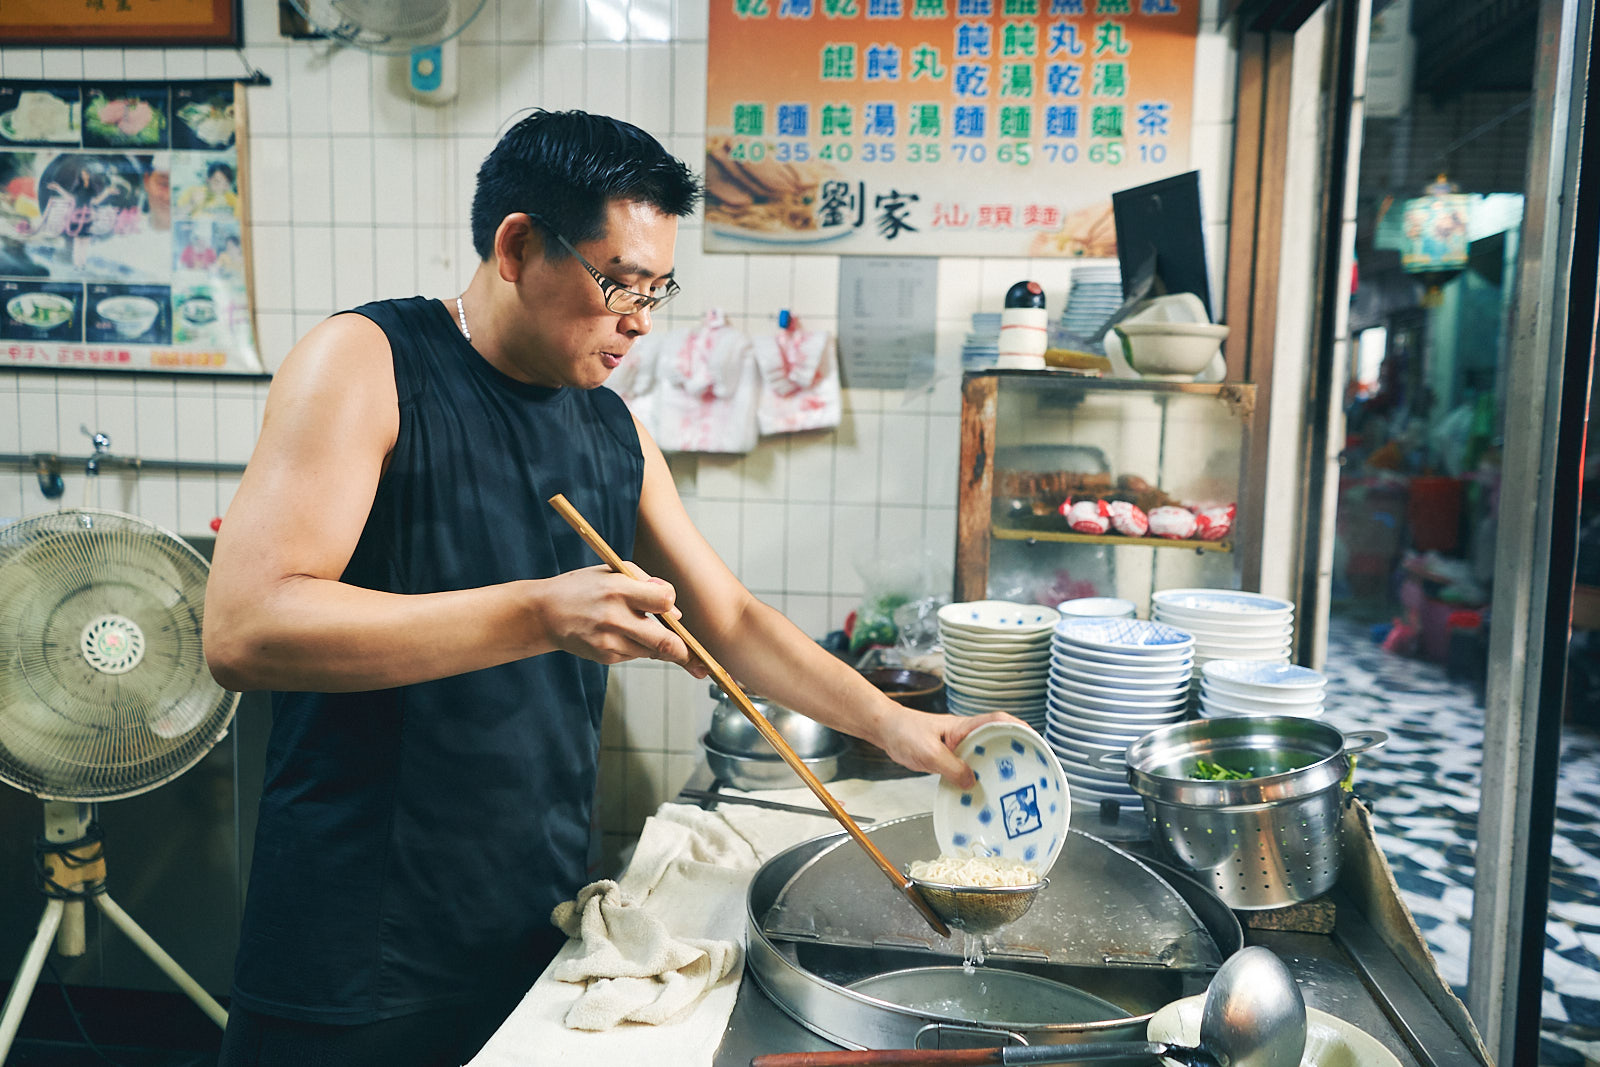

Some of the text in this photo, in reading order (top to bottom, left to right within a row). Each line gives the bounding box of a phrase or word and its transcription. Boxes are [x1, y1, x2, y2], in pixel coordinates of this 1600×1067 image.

[731, 143, 765, 161] 40
[776, 143, 810, 161] 35
[819, 143, 853, 161] 40
[862, 143, 896, 162] 35
[906, 143, 941, 162] 35
[951, 144, 986, 163] 70
[997, 142, 1031, 165] 65
[1042, 144, 1078, 163] 70
[1088, 142, 1122, 165] 65
[1139, 144, 1168, 163] 10
[818, 180, 1060, 240] 劉家 汕頭麵
